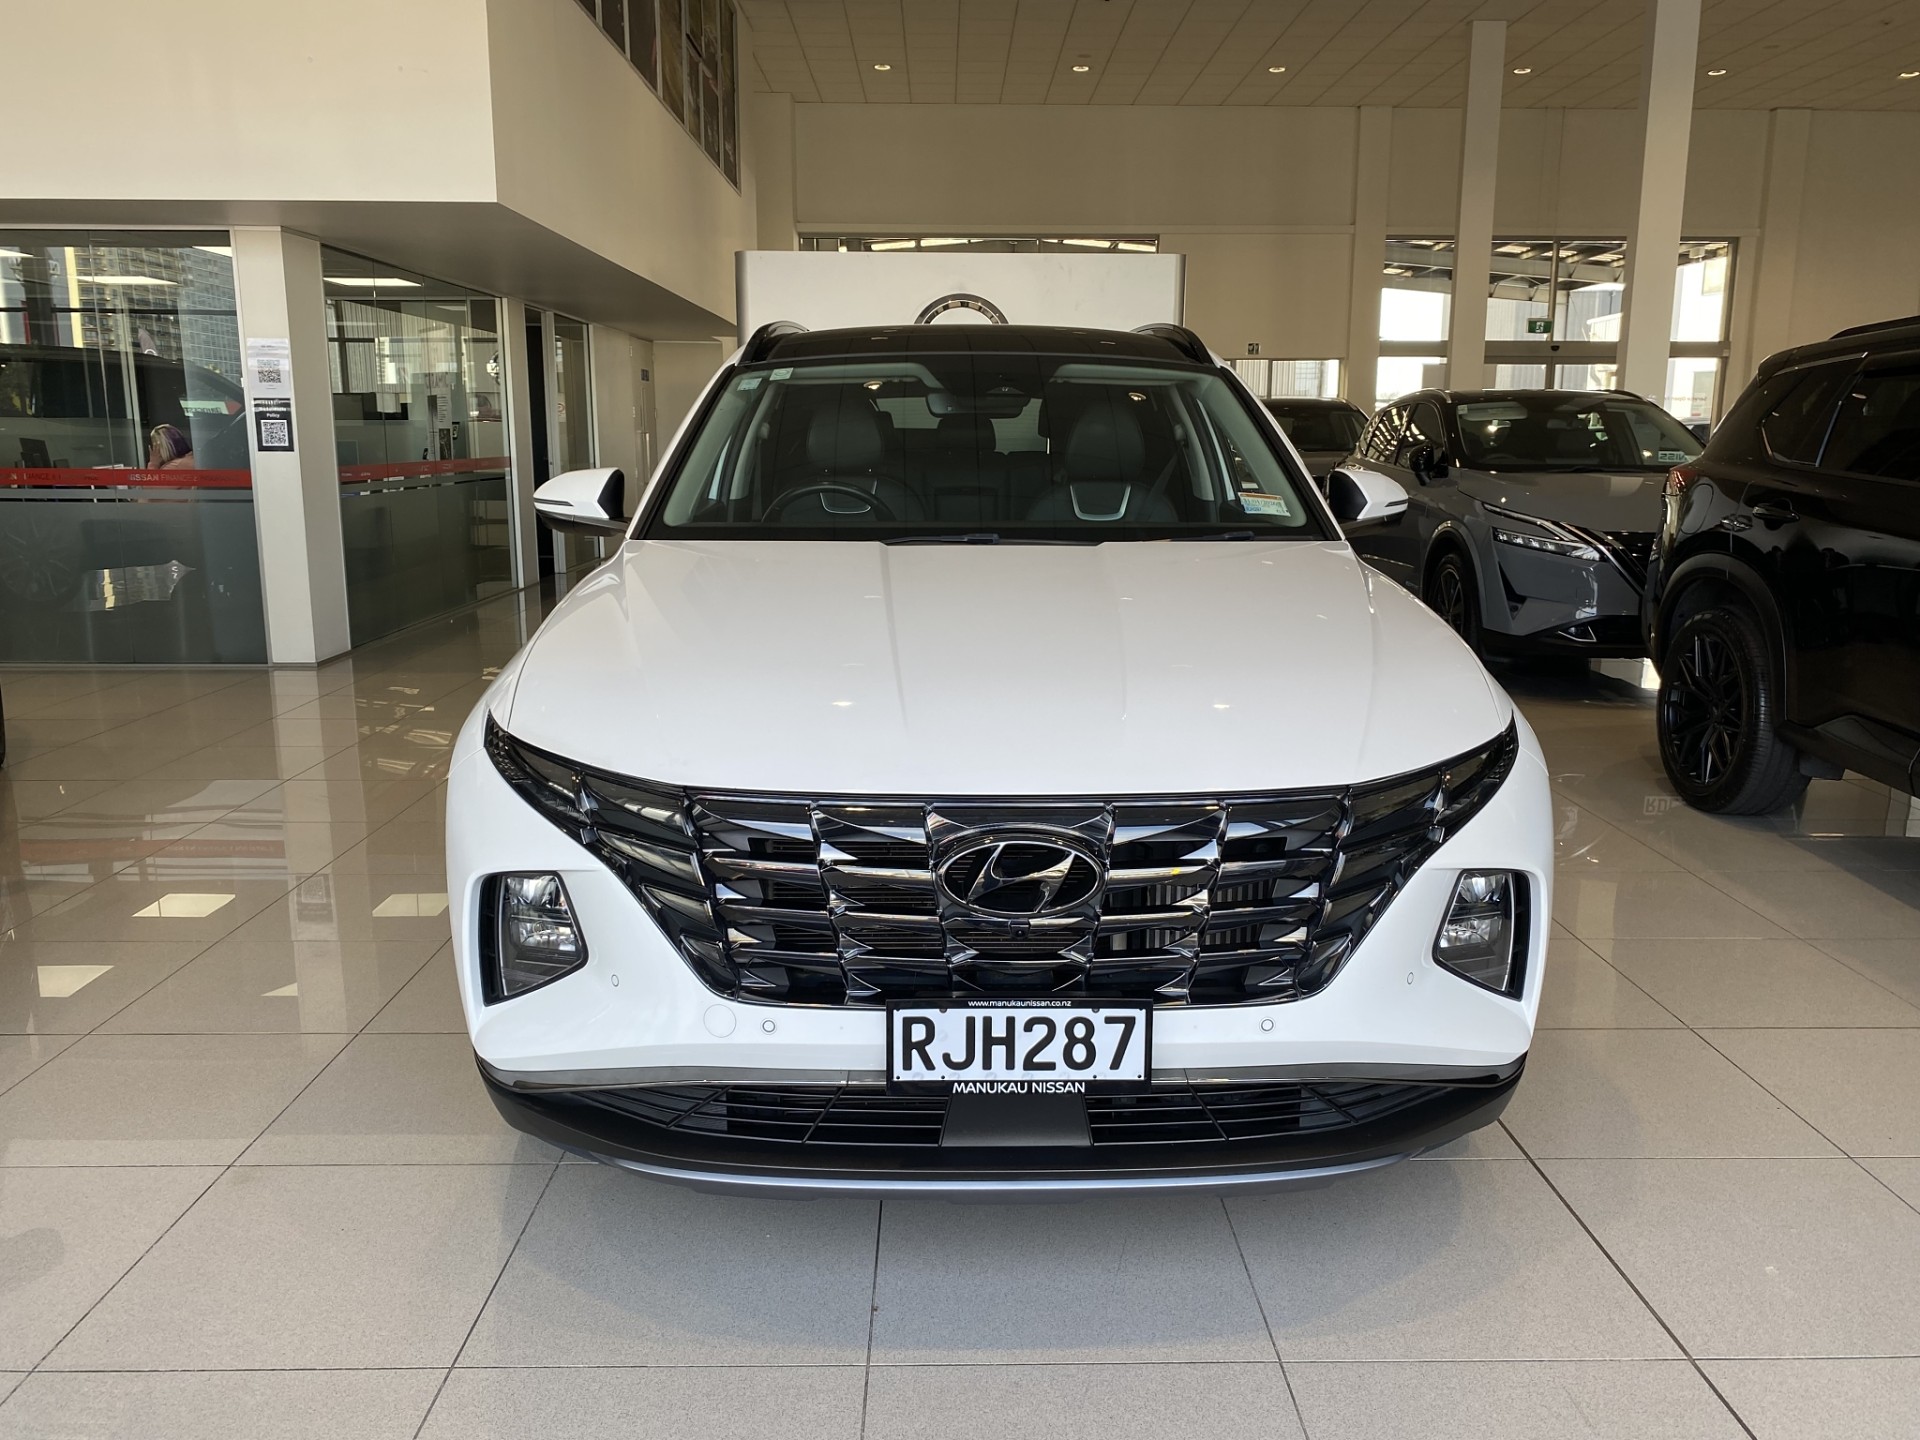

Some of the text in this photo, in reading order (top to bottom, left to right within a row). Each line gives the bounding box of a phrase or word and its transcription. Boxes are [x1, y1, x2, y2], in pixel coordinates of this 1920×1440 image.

[968, 1000, 1072, 1008] www.manukaunissan.co.nz
[902, 1016, 1136, 1071] RJH287
[952, 1081, 1085, 1094] MANUKAU NISSAN
